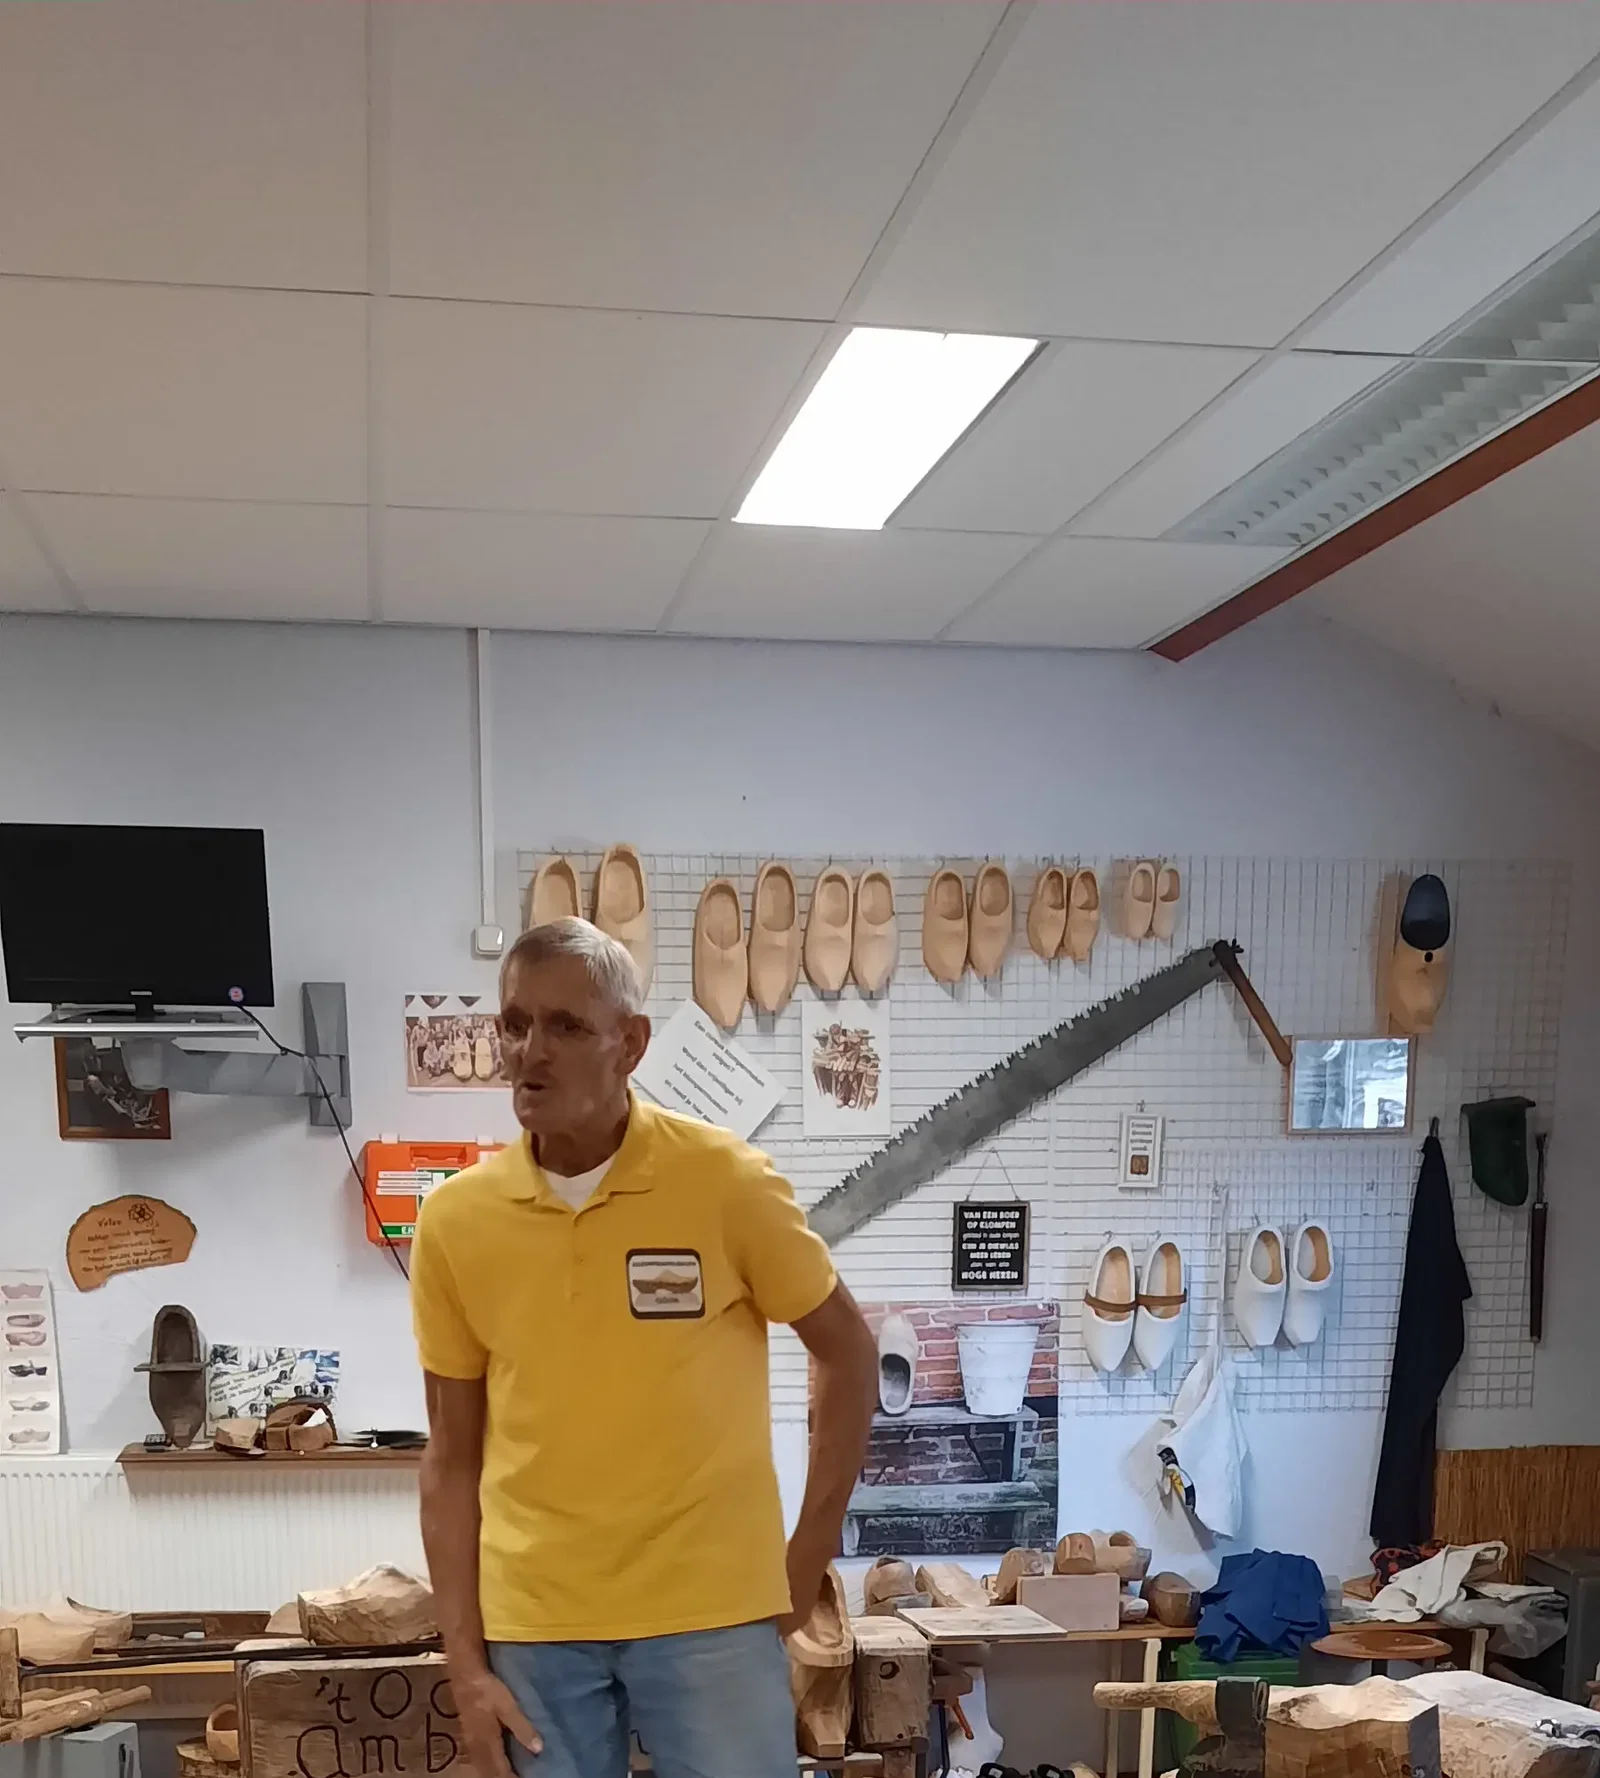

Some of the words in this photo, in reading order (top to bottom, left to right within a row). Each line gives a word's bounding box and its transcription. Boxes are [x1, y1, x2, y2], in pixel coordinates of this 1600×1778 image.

[963, 1211, 981, 1219] VAN
[982, 1211, 998, 1219] EEN
[966, 1221, 979, 1229] OP
[979, 1221, 1017, 1229] KLOMPEN
